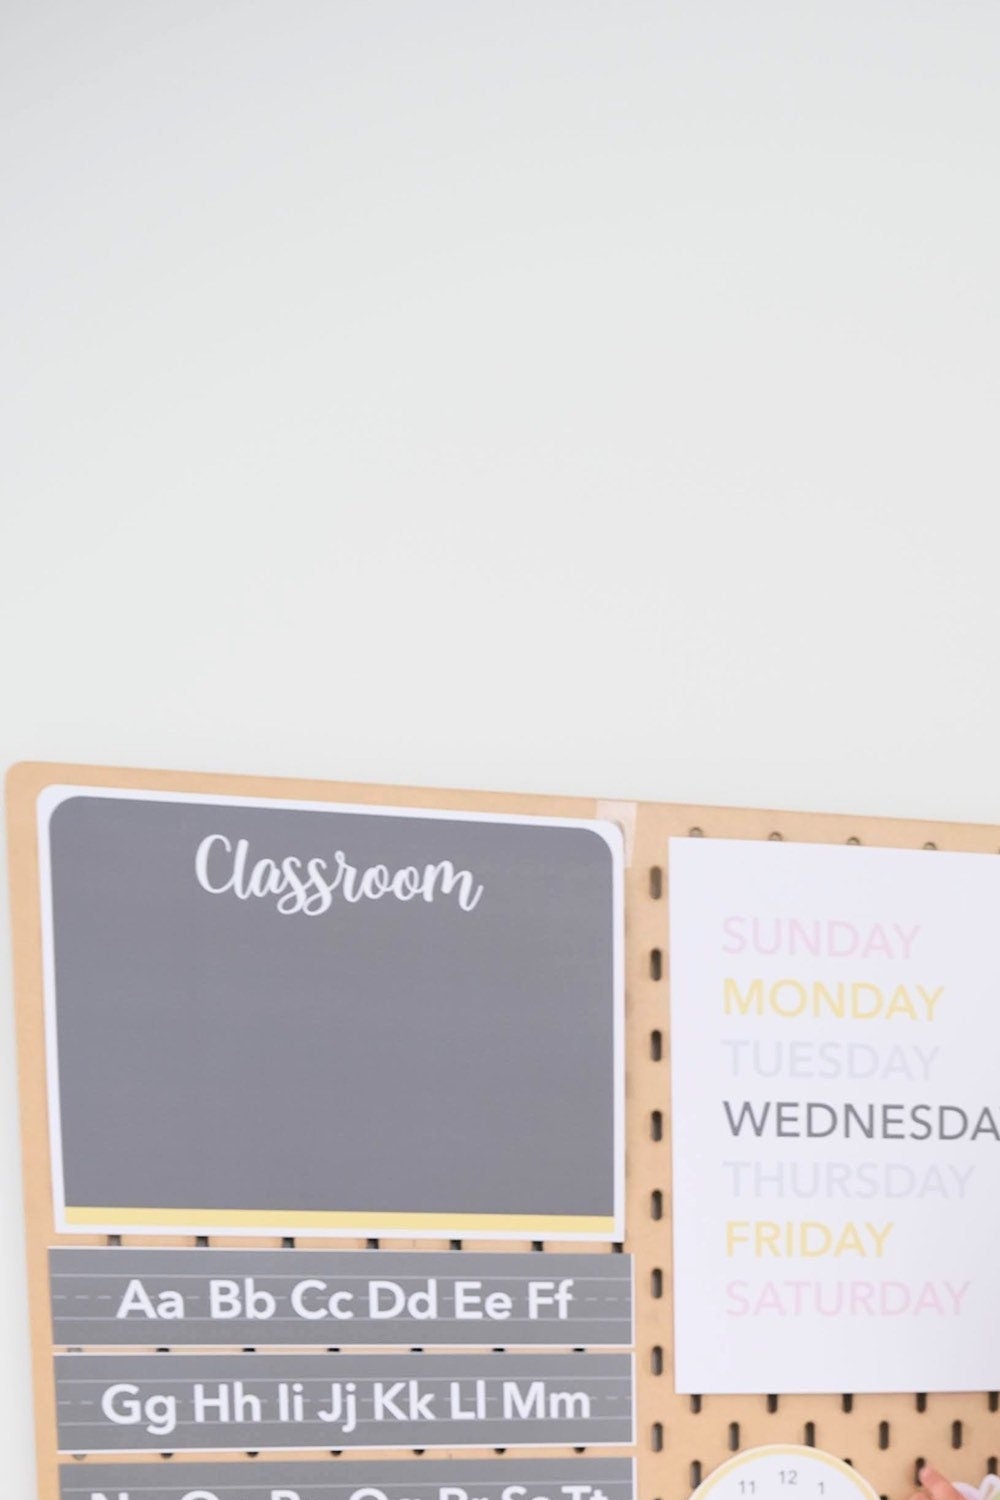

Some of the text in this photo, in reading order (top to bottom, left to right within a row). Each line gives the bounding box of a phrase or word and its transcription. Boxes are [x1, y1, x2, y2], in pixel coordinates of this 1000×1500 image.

[195, 833, 484, 916] Classroom
[722, 917, 921, 960] SUNDAY
[723, 978, 945, 1022] MONDAY
[722, 1039, 940, 1082] TUESDAY
[723, 1162, 975, 1199] THURSDAY
[726, 1220, 894, 1259] FRIDAY
[117, 1278, 573, 1320] Aa Bb Cc Dd Ee Ff
[725, 1280, 971, 1317] SATURDAY
[102, 1380, 590, 1436] Gg Hh Ii Jj Kk Ll Mm
[740, 1481, 756, 1494] 11
[778, 1470, 798, 1485] 12
[818, 1481, 824, 1494] 1
